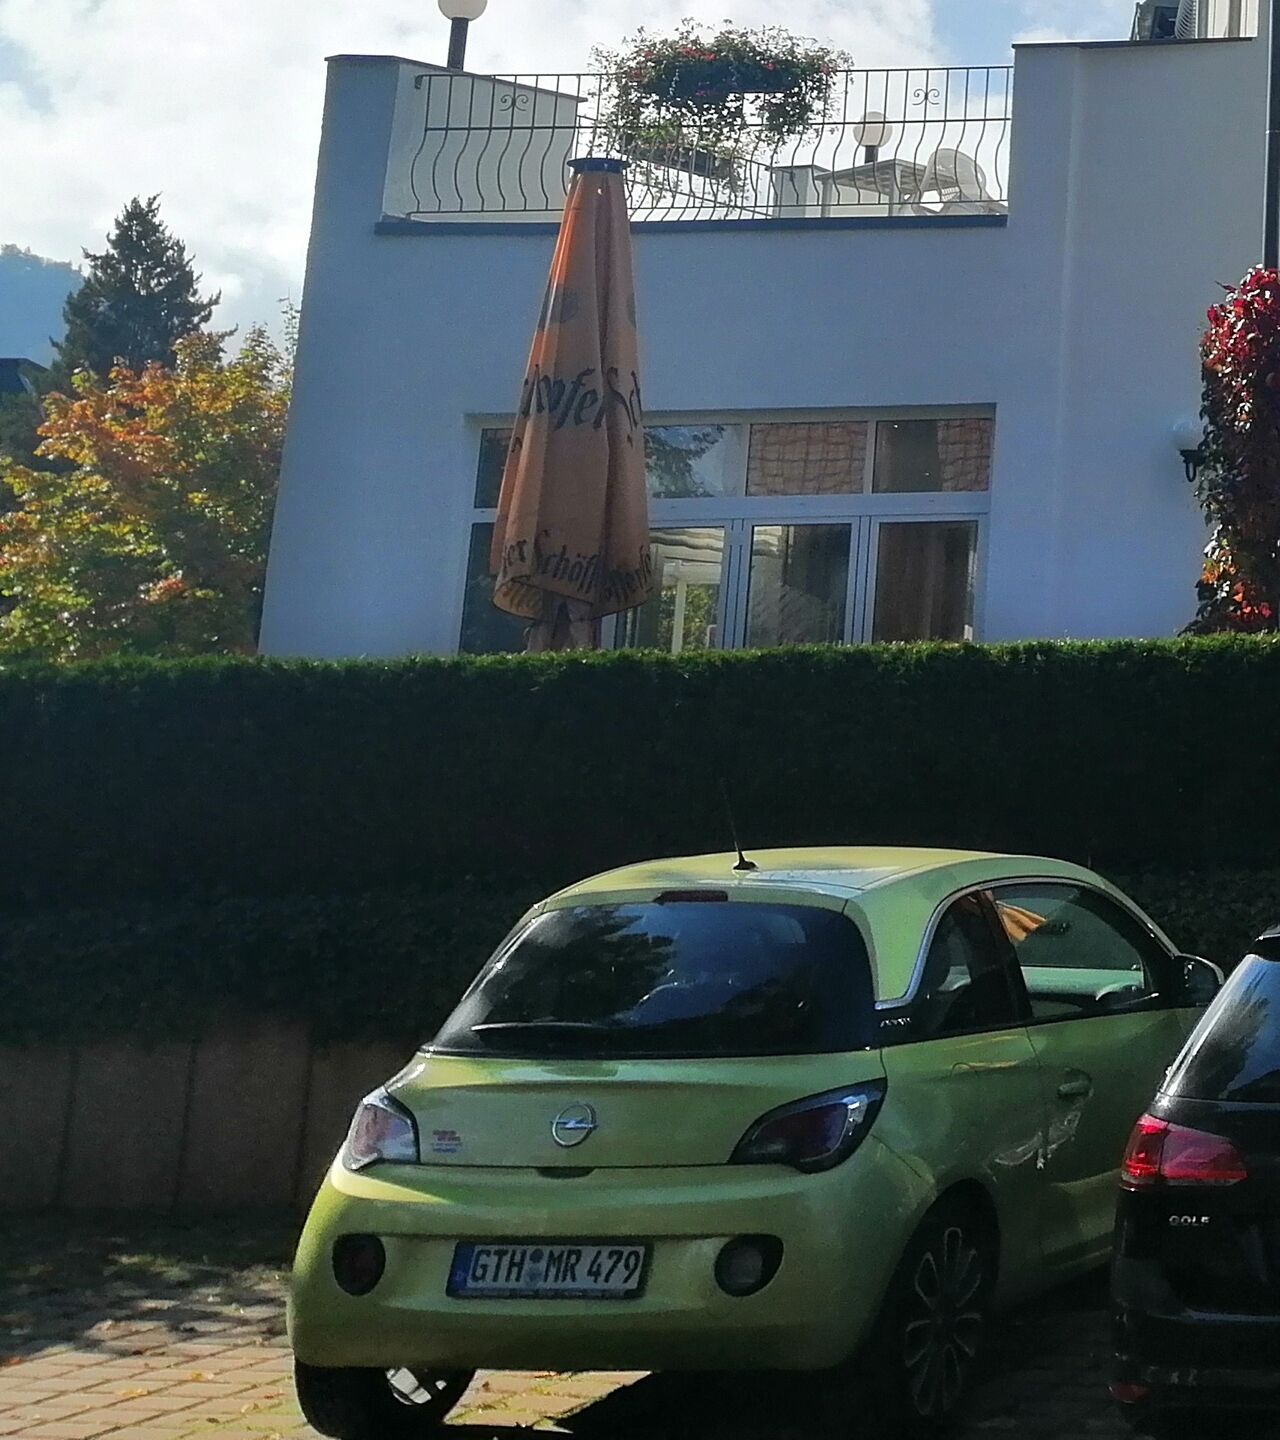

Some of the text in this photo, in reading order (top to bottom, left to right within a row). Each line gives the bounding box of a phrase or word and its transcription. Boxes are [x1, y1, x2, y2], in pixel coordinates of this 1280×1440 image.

[472, 1249, 528, 1284] GTH
[543, 1249, 583, 1283] MR
[586, 1249, 642, 1284] 479
